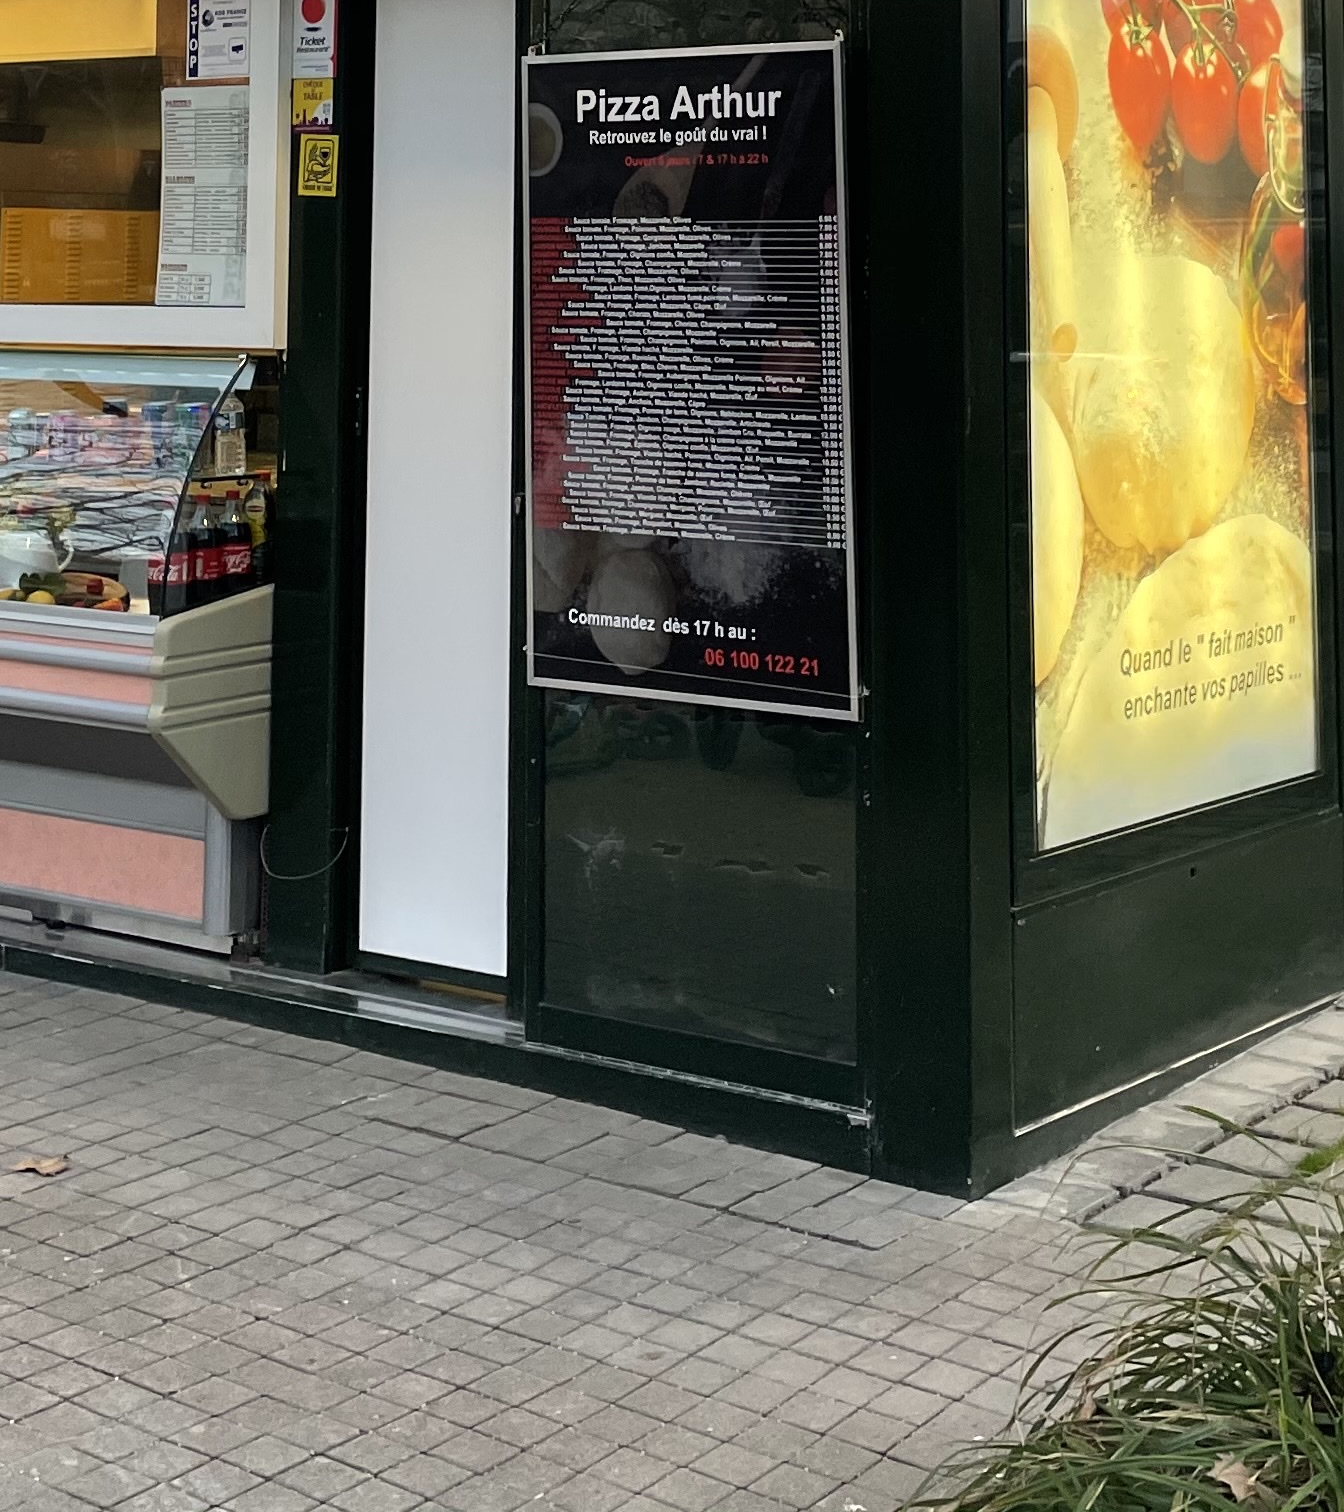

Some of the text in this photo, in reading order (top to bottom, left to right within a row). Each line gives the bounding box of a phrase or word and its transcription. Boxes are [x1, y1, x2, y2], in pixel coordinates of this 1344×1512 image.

[189, 3, 199, 69] STOP
[300, 37, 326, 46] Ticket
[576, 83, 782, 123] Pizza Arthur
[590, 126, 767, 147] Retrouvez le goût du vrai !
[706, 154, 714, 165] &
[747, 154, 759, 164] 22
[568, 608, 656, 632] Commandez
[663, 617, 690, 635] dès
[693, 620, 711, 636] 17
[715, 621, 724, 638] h
[728, 626, 747, 640] au
[705, 648, 819, 677] 06 100 122 21
[1120, 640, 1173, 678] Quand
[1178, 640, 1192, 663] le
[1208, 629, 1232, 660] fait
[1234, 621, 1284, 653] maison
[1124, 680, 1197, 720] enchante
[1201, 677, 1226, 703] vos
[1228, 660, 1284, 702] papilles
